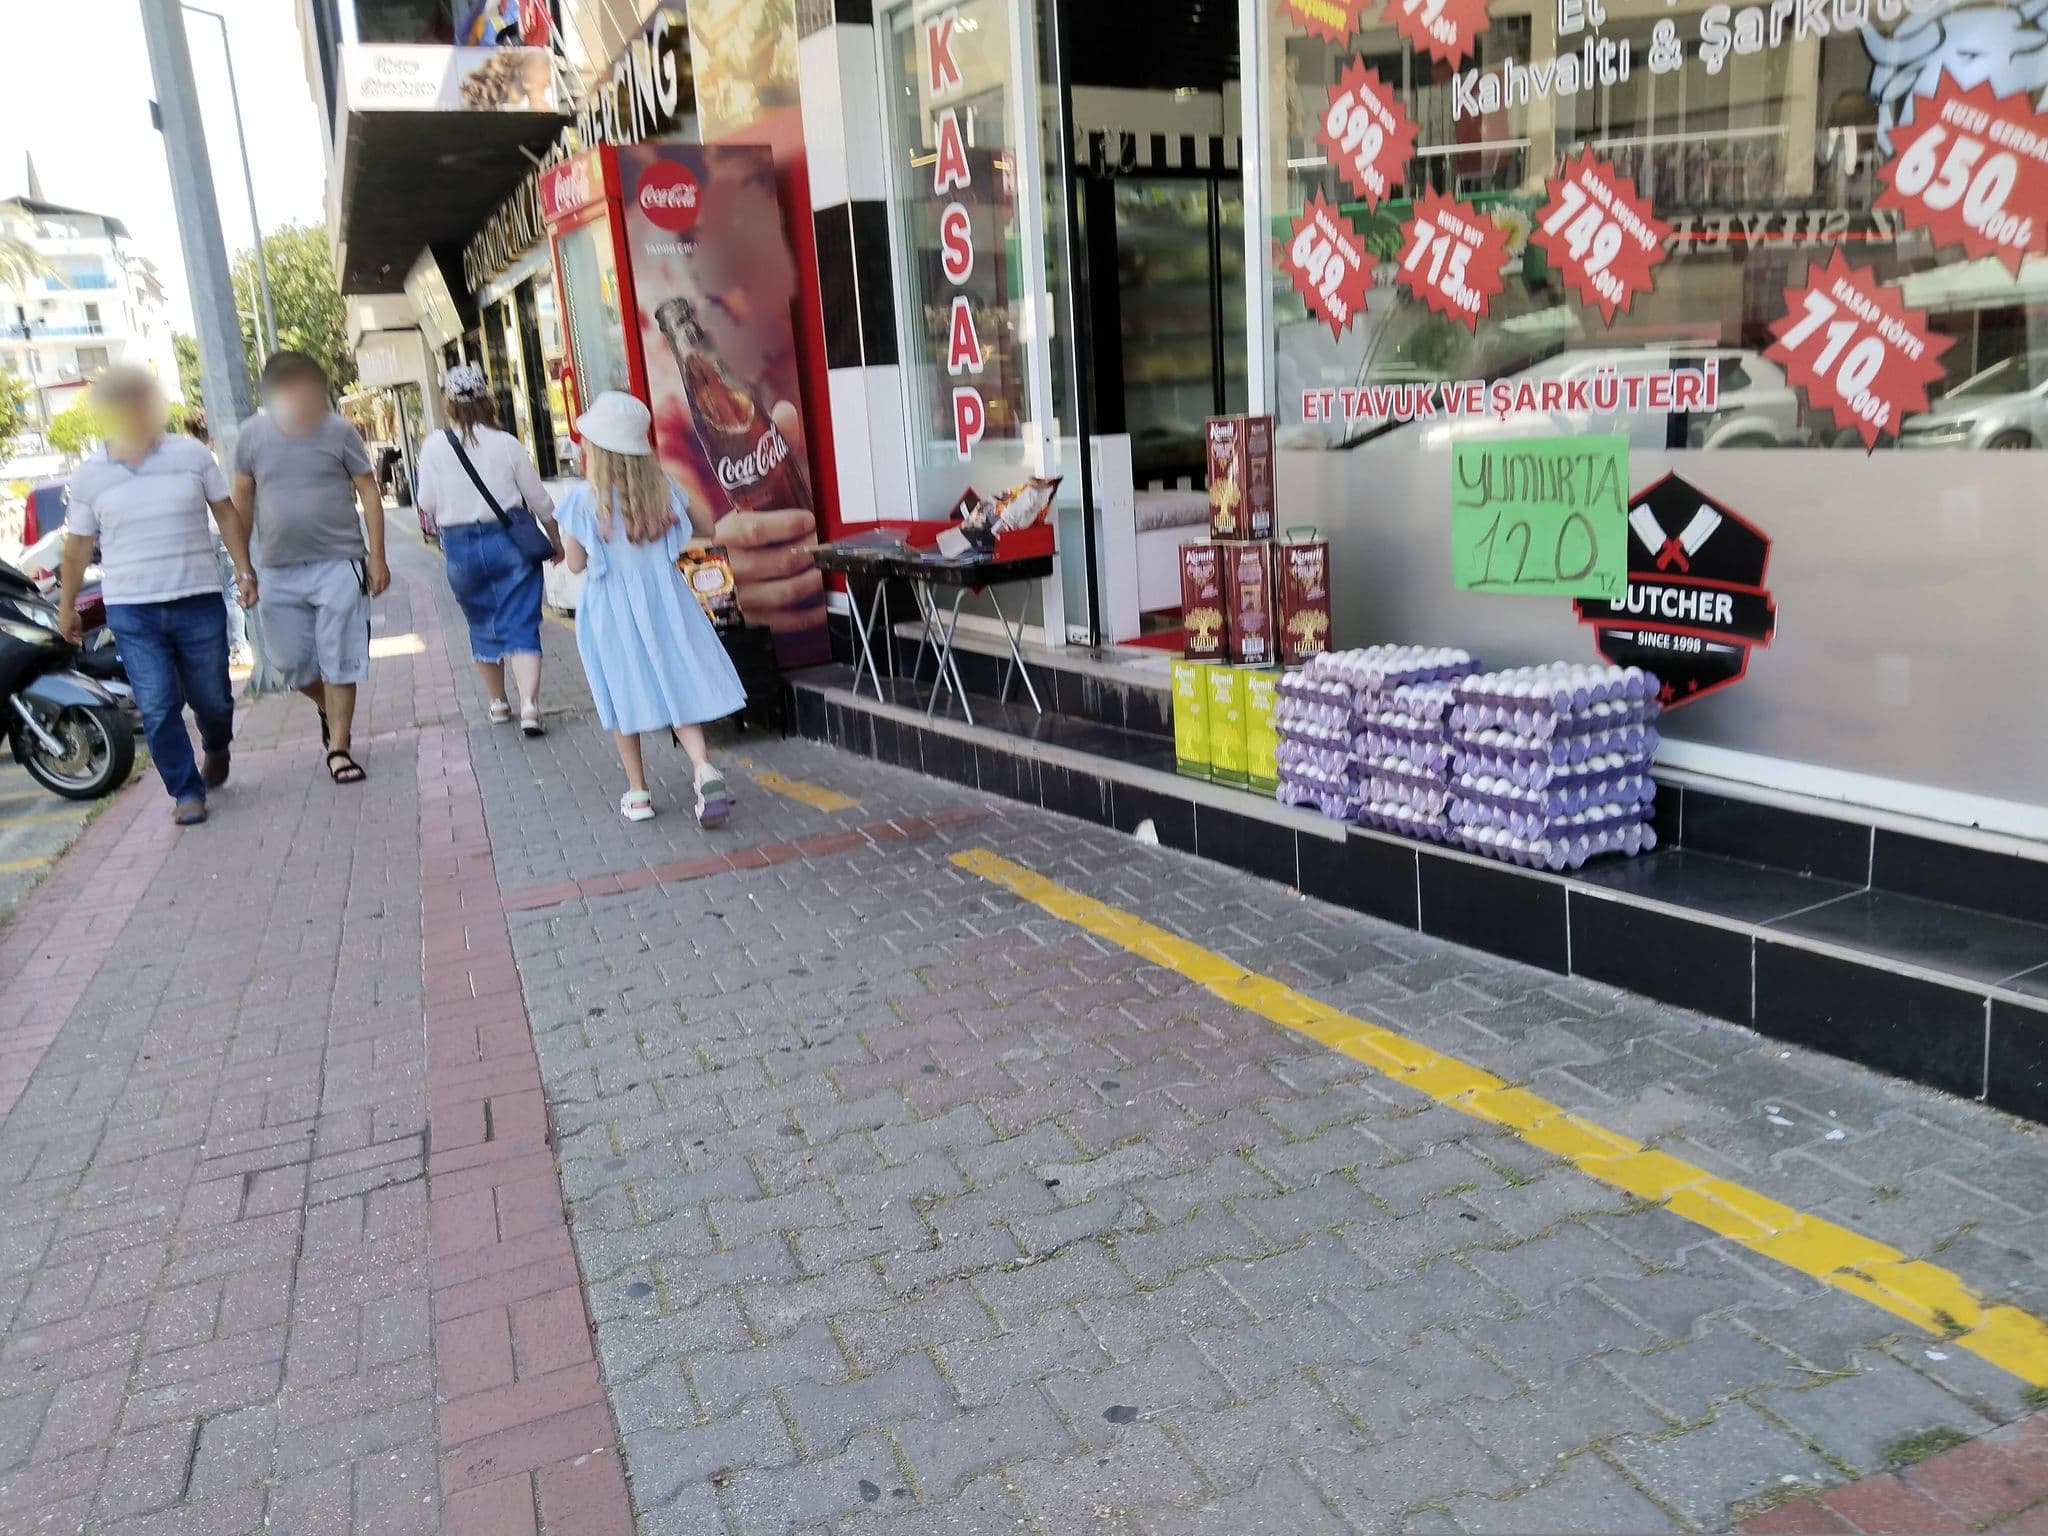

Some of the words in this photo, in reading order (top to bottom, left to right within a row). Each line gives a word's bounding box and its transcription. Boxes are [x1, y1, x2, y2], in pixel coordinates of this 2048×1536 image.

[1453, 35, 1631, 121] Kahvaltı
[1648, 18, 1683, 74] &
[1940, 99, 1990, 135] KUZU
[925, 8, 985, 461] KASAP
[1831, 276, 1881, 323] KASAP
[1302, 388, 1336, 422] ET
[1339, 384, 1435, 422] TAVUK
[1440, 380, 1486, 418] VE
[1491, 358, 1719, 425] ŞARKÜTERİ
[718, 421, 789, 490] Coca-Cola
[1457, 451, 1624, 513] YUMURTA
[1468, 511, 1599, 589] 120
[1637, 631, 1670, 649] SINCE
